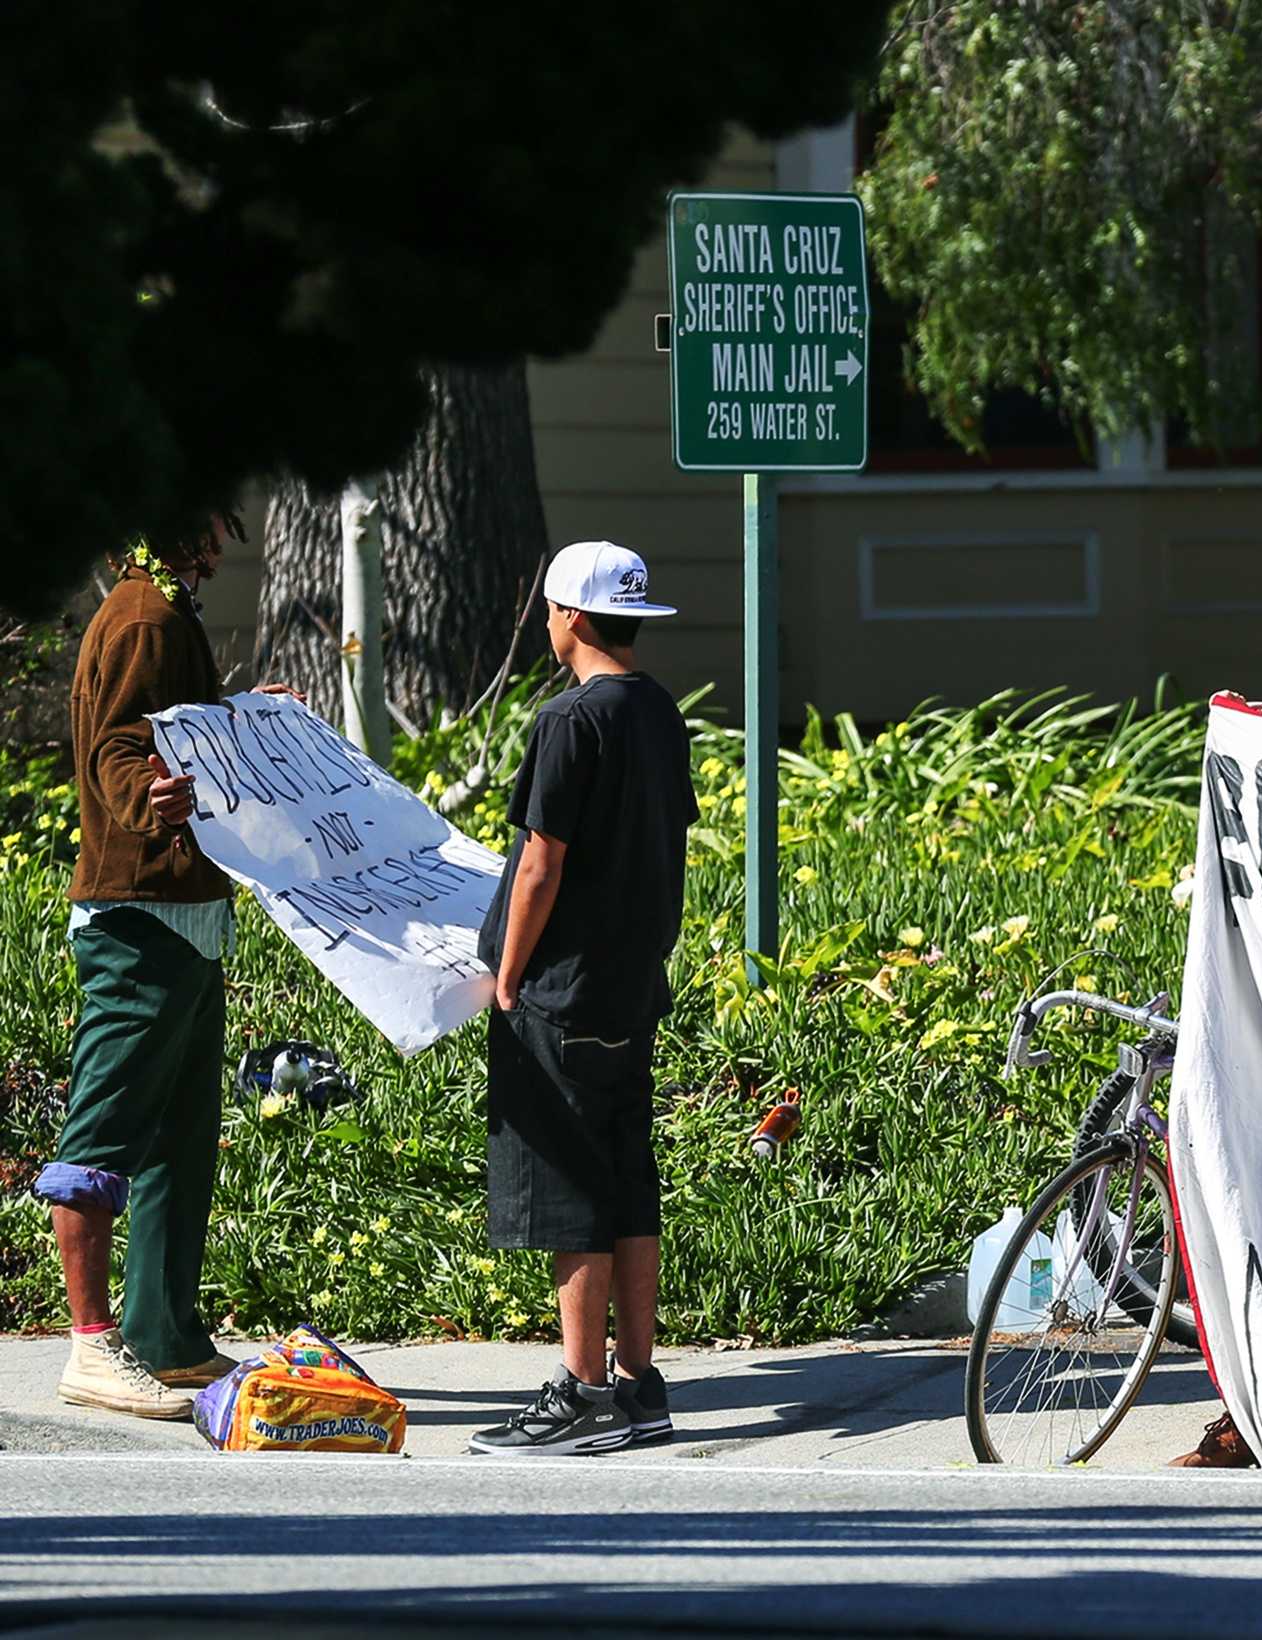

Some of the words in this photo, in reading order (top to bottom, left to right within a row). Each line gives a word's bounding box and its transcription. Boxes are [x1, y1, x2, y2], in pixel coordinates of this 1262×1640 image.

[694, 223, 774, 274] SANTA
[784, 225, 844, 275] CRUZ
[684, 282, 785, 334] SHERIFF'S
[794, 285, 859, 334] OFFICE
[712, 343, 774, 392] MAIN
[784, 345, 833, 392] JAIL
[707, 402, 742, 439] 259
[750, 403, 807, 440] WATER
[816, 404, 840, 440] ST.
